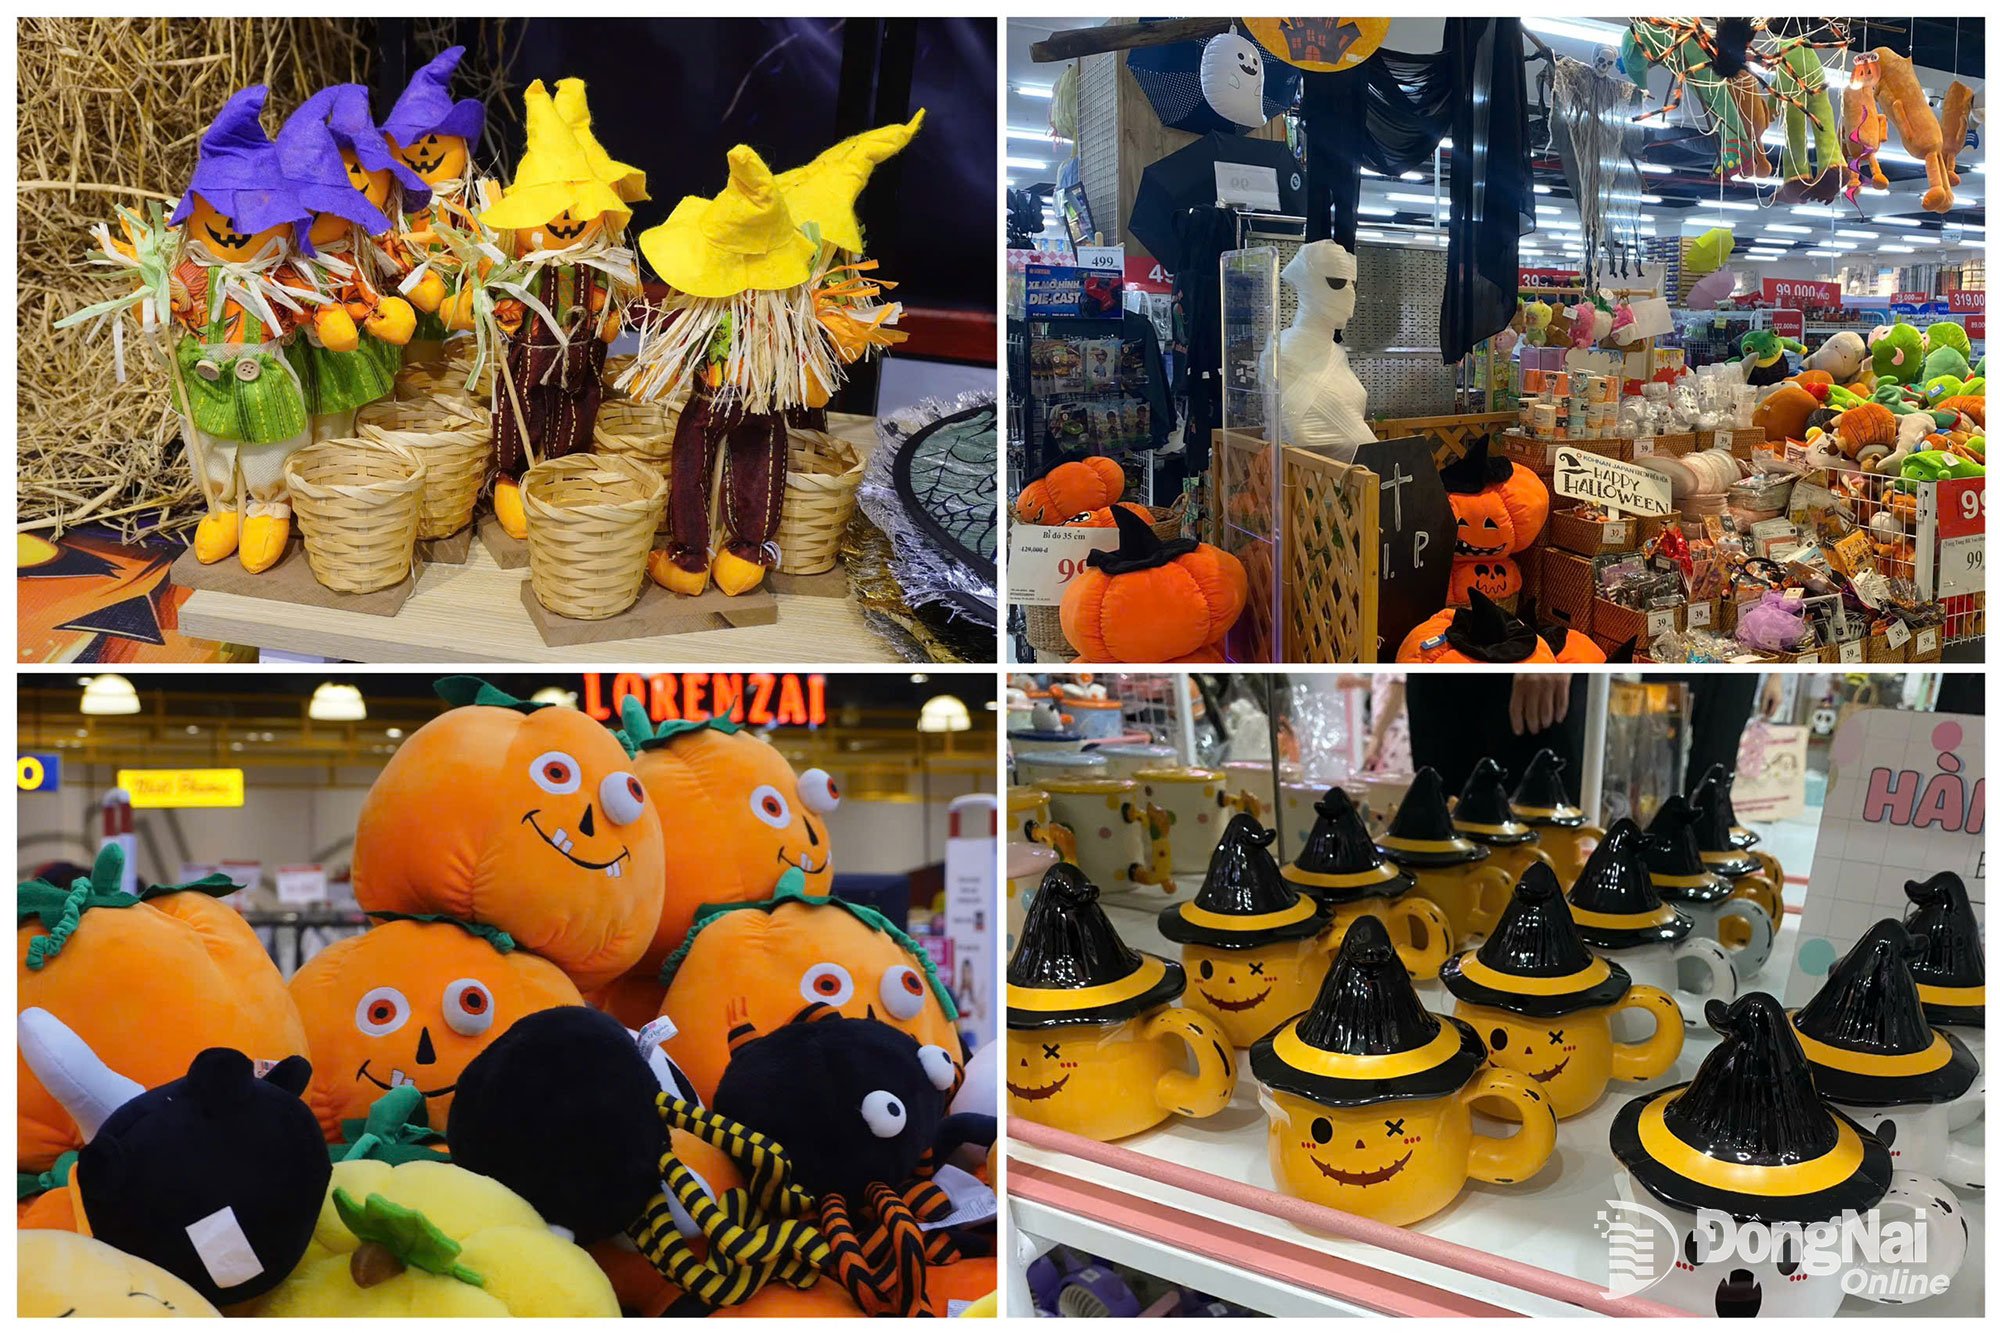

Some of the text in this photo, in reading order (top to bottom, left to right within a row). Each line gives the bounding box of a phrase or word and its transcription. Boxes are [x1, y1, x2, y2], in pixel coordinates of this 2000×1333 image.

[1092, 256, 1114, 266] 499
[1029, 292, 1081, 305] DIE-CAST
[1594, 467, 1640, 492] HAPPY
[1564, 474, 1669, 514] HALLOWEEN
[1063, 532, 1072, 540] 35
[1695, 610, 1704, 618] 39
[1656, 618, 1666, 628] 39
[1896, 630, 1904, 638] 39
[1922, 638, 1930, 646] 39
[1846, 650, 1854, 658] 39
[583, 673, 826, 725] LORENZAI
